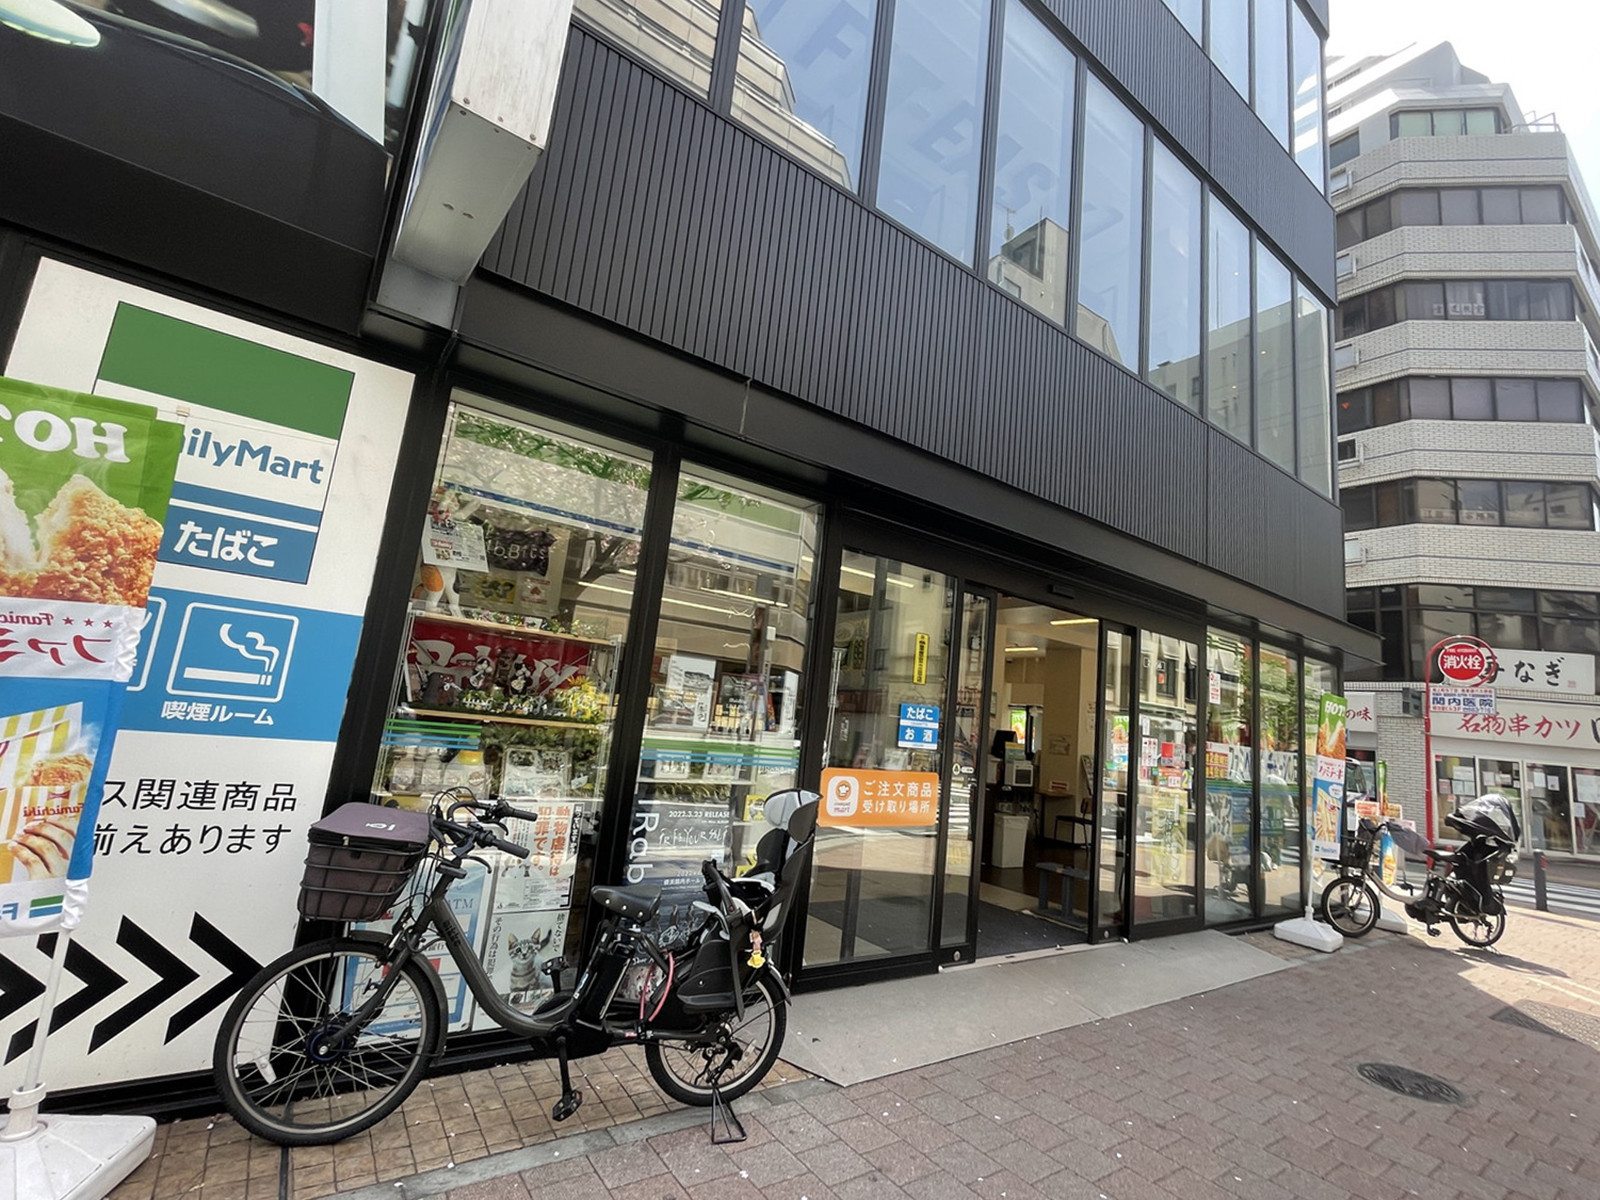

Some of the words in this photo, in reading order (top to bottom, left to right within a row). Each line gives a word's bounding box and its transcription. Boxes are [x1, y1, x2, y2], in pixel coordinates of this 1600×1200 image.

[180, 427, 324, 485] ilyMart
[173, 521, 279, 568] たばこ
[1443, 654, 1482, 669] 消火栓
[161, 700, 274, 725] 喫煙ルーム
[1432, 697, 1493, 707] 関内医院
[906, 707, 934, 721] たばこ
[1457, 713, 1581, 740] 名物串カツ
[102, 778, 297, 811] ス関連商品
[863, 780, 932, 798] ご注文商品
[862, 800, 930, 814] 受け取り場所
